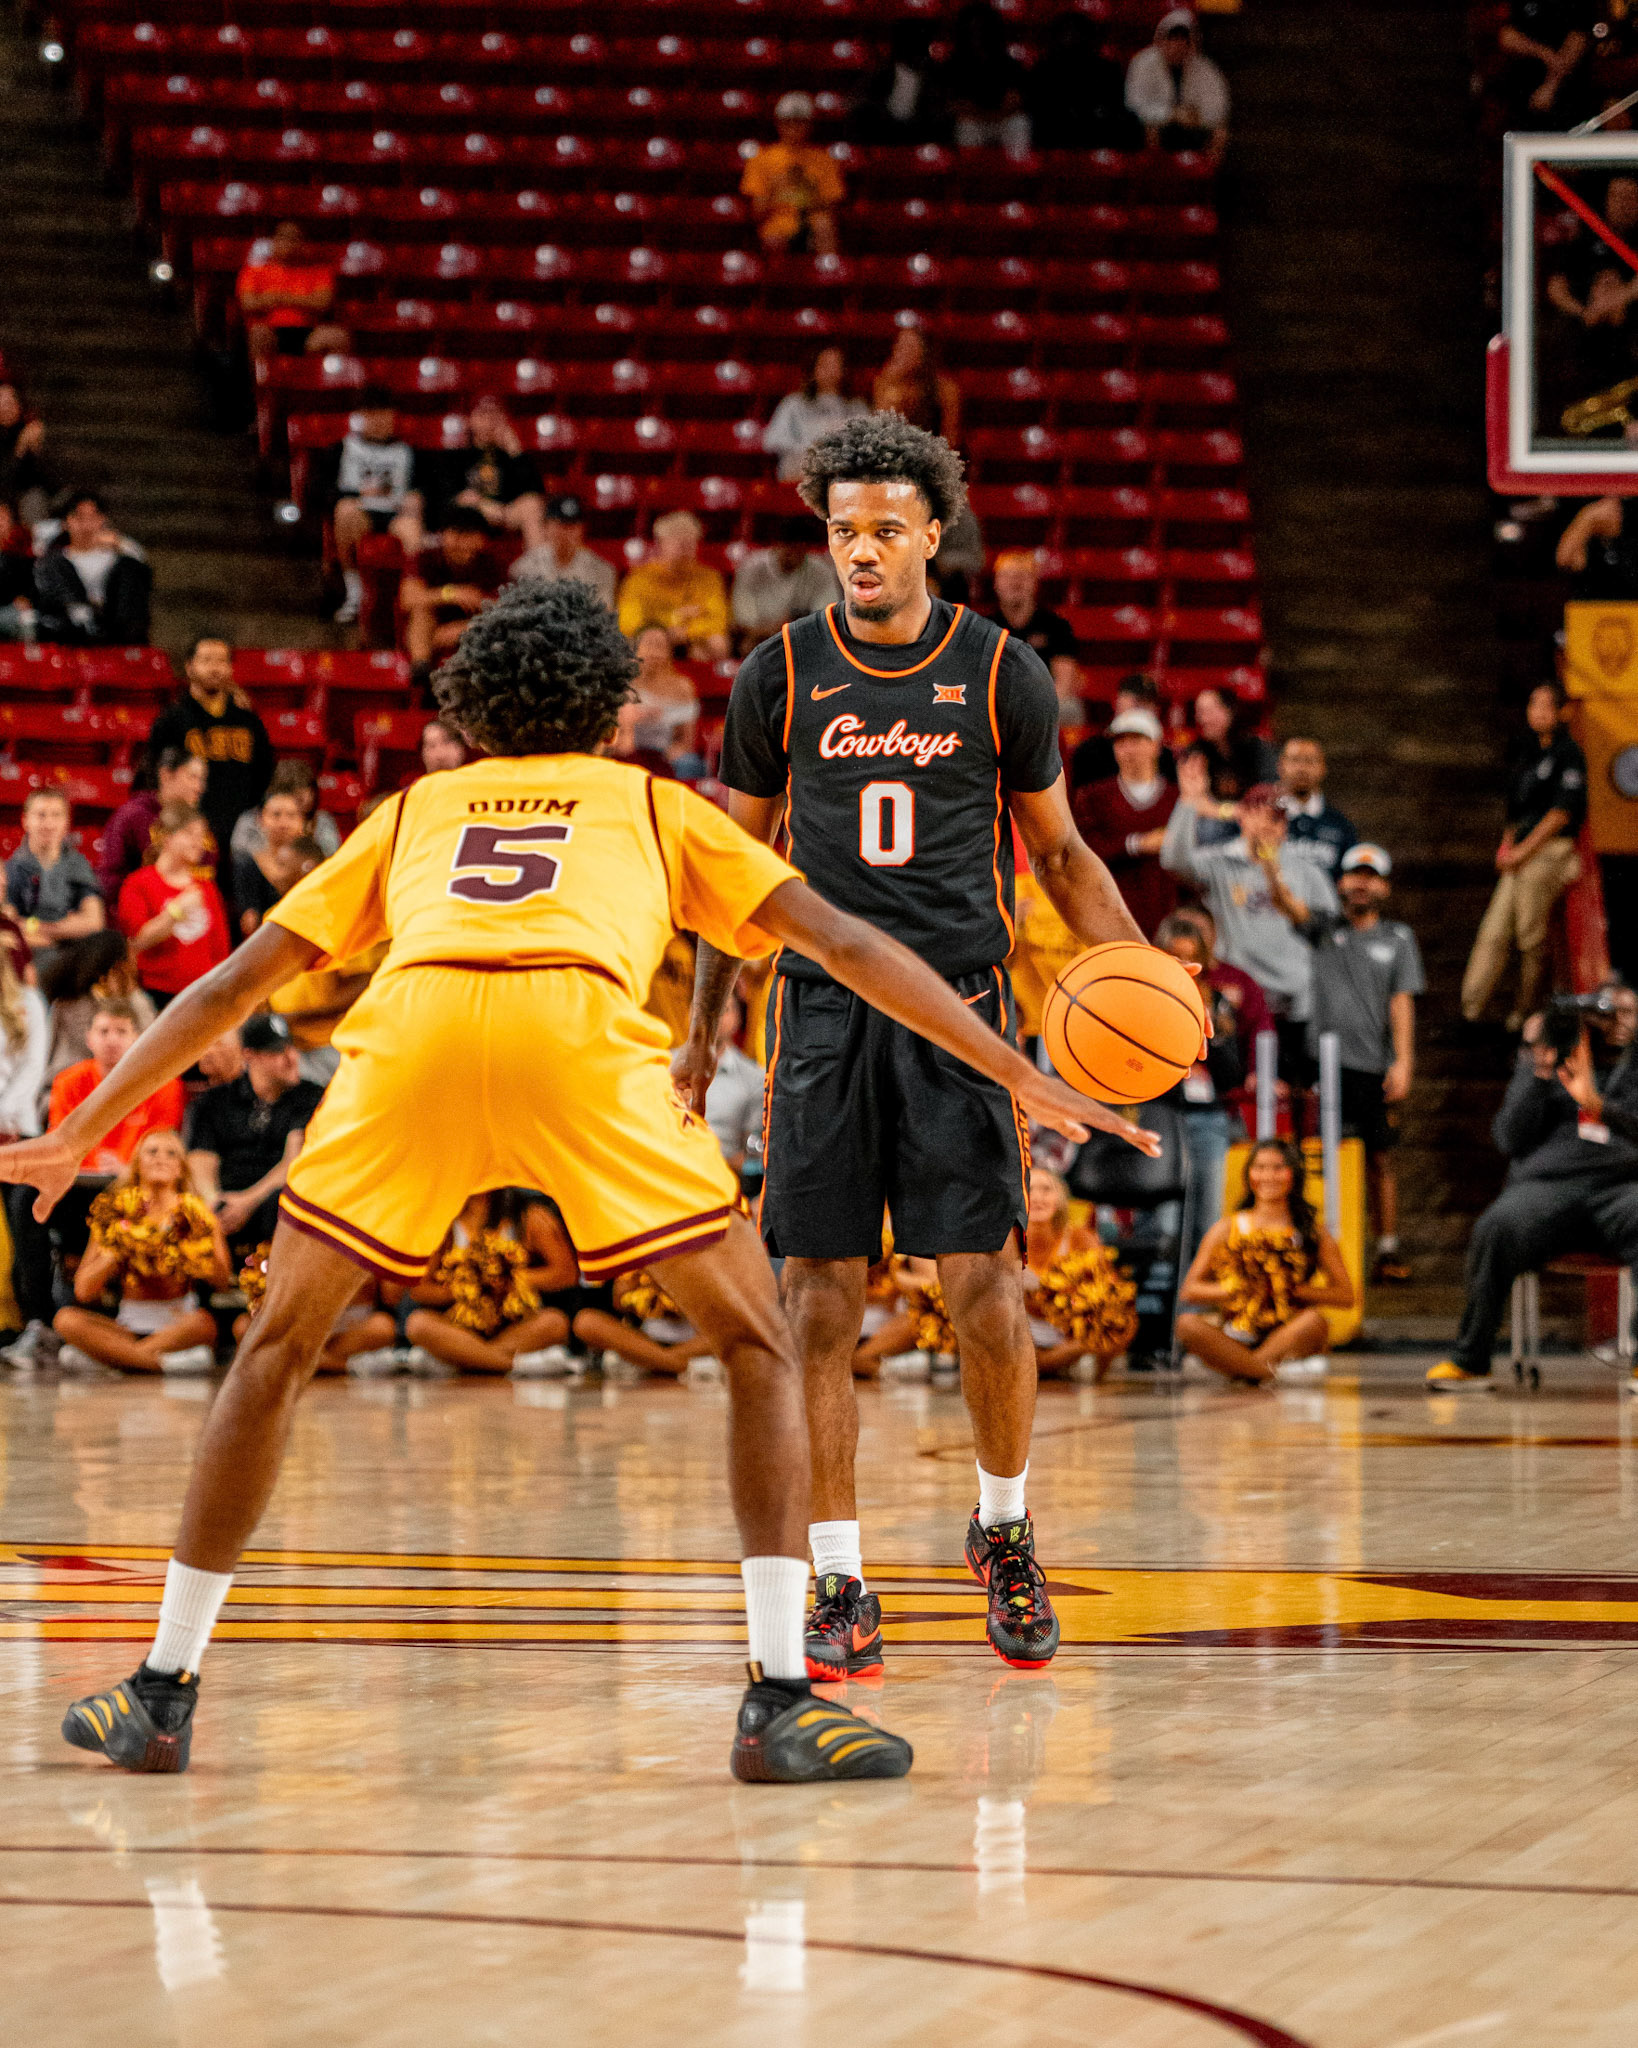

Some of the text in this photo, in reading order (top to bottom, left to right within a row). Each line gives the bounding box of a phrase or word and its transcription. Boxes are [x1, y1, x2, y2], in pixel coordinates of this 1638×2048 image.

[819, 713, 963, 767] Cowboys
[468, 799, 580, 817] ODUM
[859, 781, 915, 867] 0
[447, 825, 573, 905] 5
